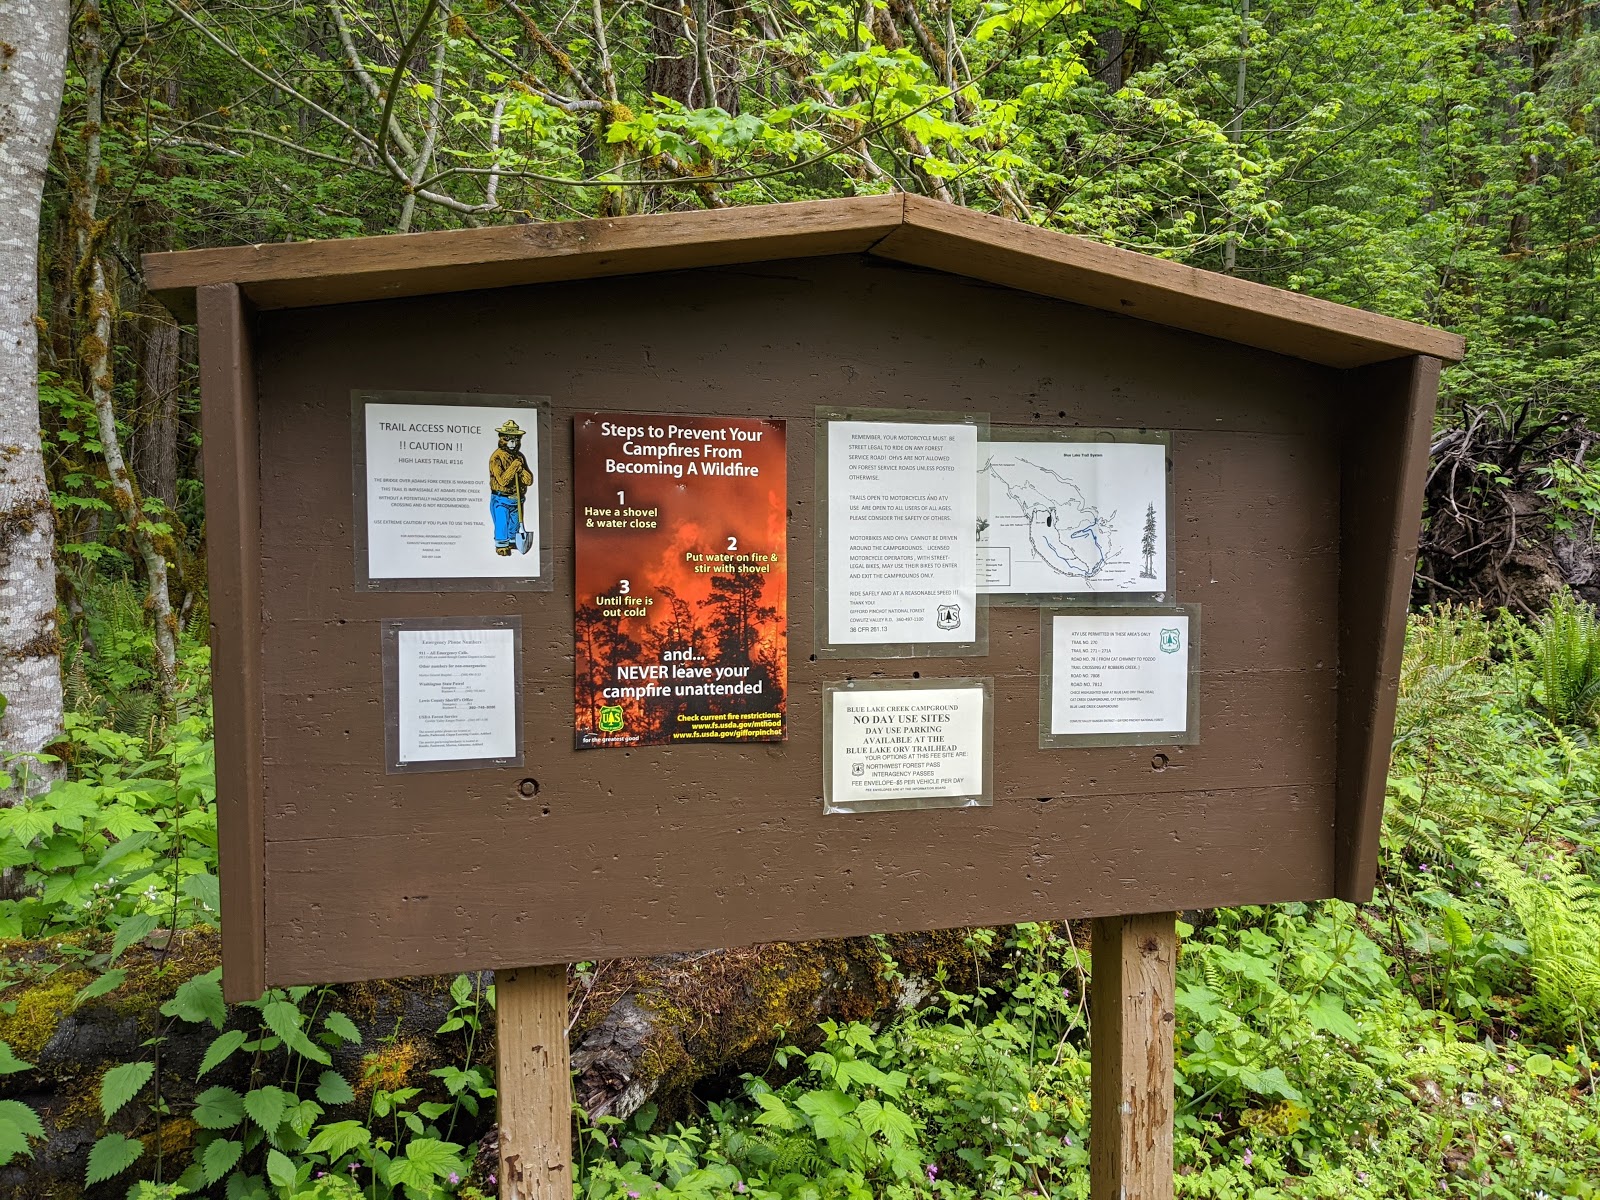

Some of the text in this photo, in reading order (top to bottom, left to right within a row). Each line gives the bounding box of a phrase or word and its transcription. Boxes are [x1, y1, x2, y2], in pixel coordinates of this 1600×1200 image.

[380, 423, 481, 434] TRAIL ACCESS NOTICE
[601, 422, 762, 442] Steps to Prevent Your
[400, 441, 462, 451] !! CAUTION !!
[623, 442, 742, 459] Campfires From
[606, 459, 759, 478] Becoming A Wildfire
[617, 491, 624, 504] 1
[585, 507, 612, 516] Have
[623, 508, 657, 517] shovel
[586, 519, 657, 528] & water close
[728, 537, 737, 550] 2
[686, 553, 703, 562] Put
[751, 553, 768, 562] fire
[695, 564, 770, 573] stir with shovel
[620, 580, 630, 593] 3
[596, 597, 653, 606] Until fire is
[603, 608, 646, 617] out cold
[664, 647, 705, 661] and...
[618, 665, 749, 681] NEVER leave your
[603, 680, 762, 700] campfire unattended
[853, 714, 950, 724] NO DAY USE SITES
[692, 720, 781, 729] www.fs.usda.gov/mthood
[673, 729, 781, 738] www.fs.usda.gov/gifforpinchot
